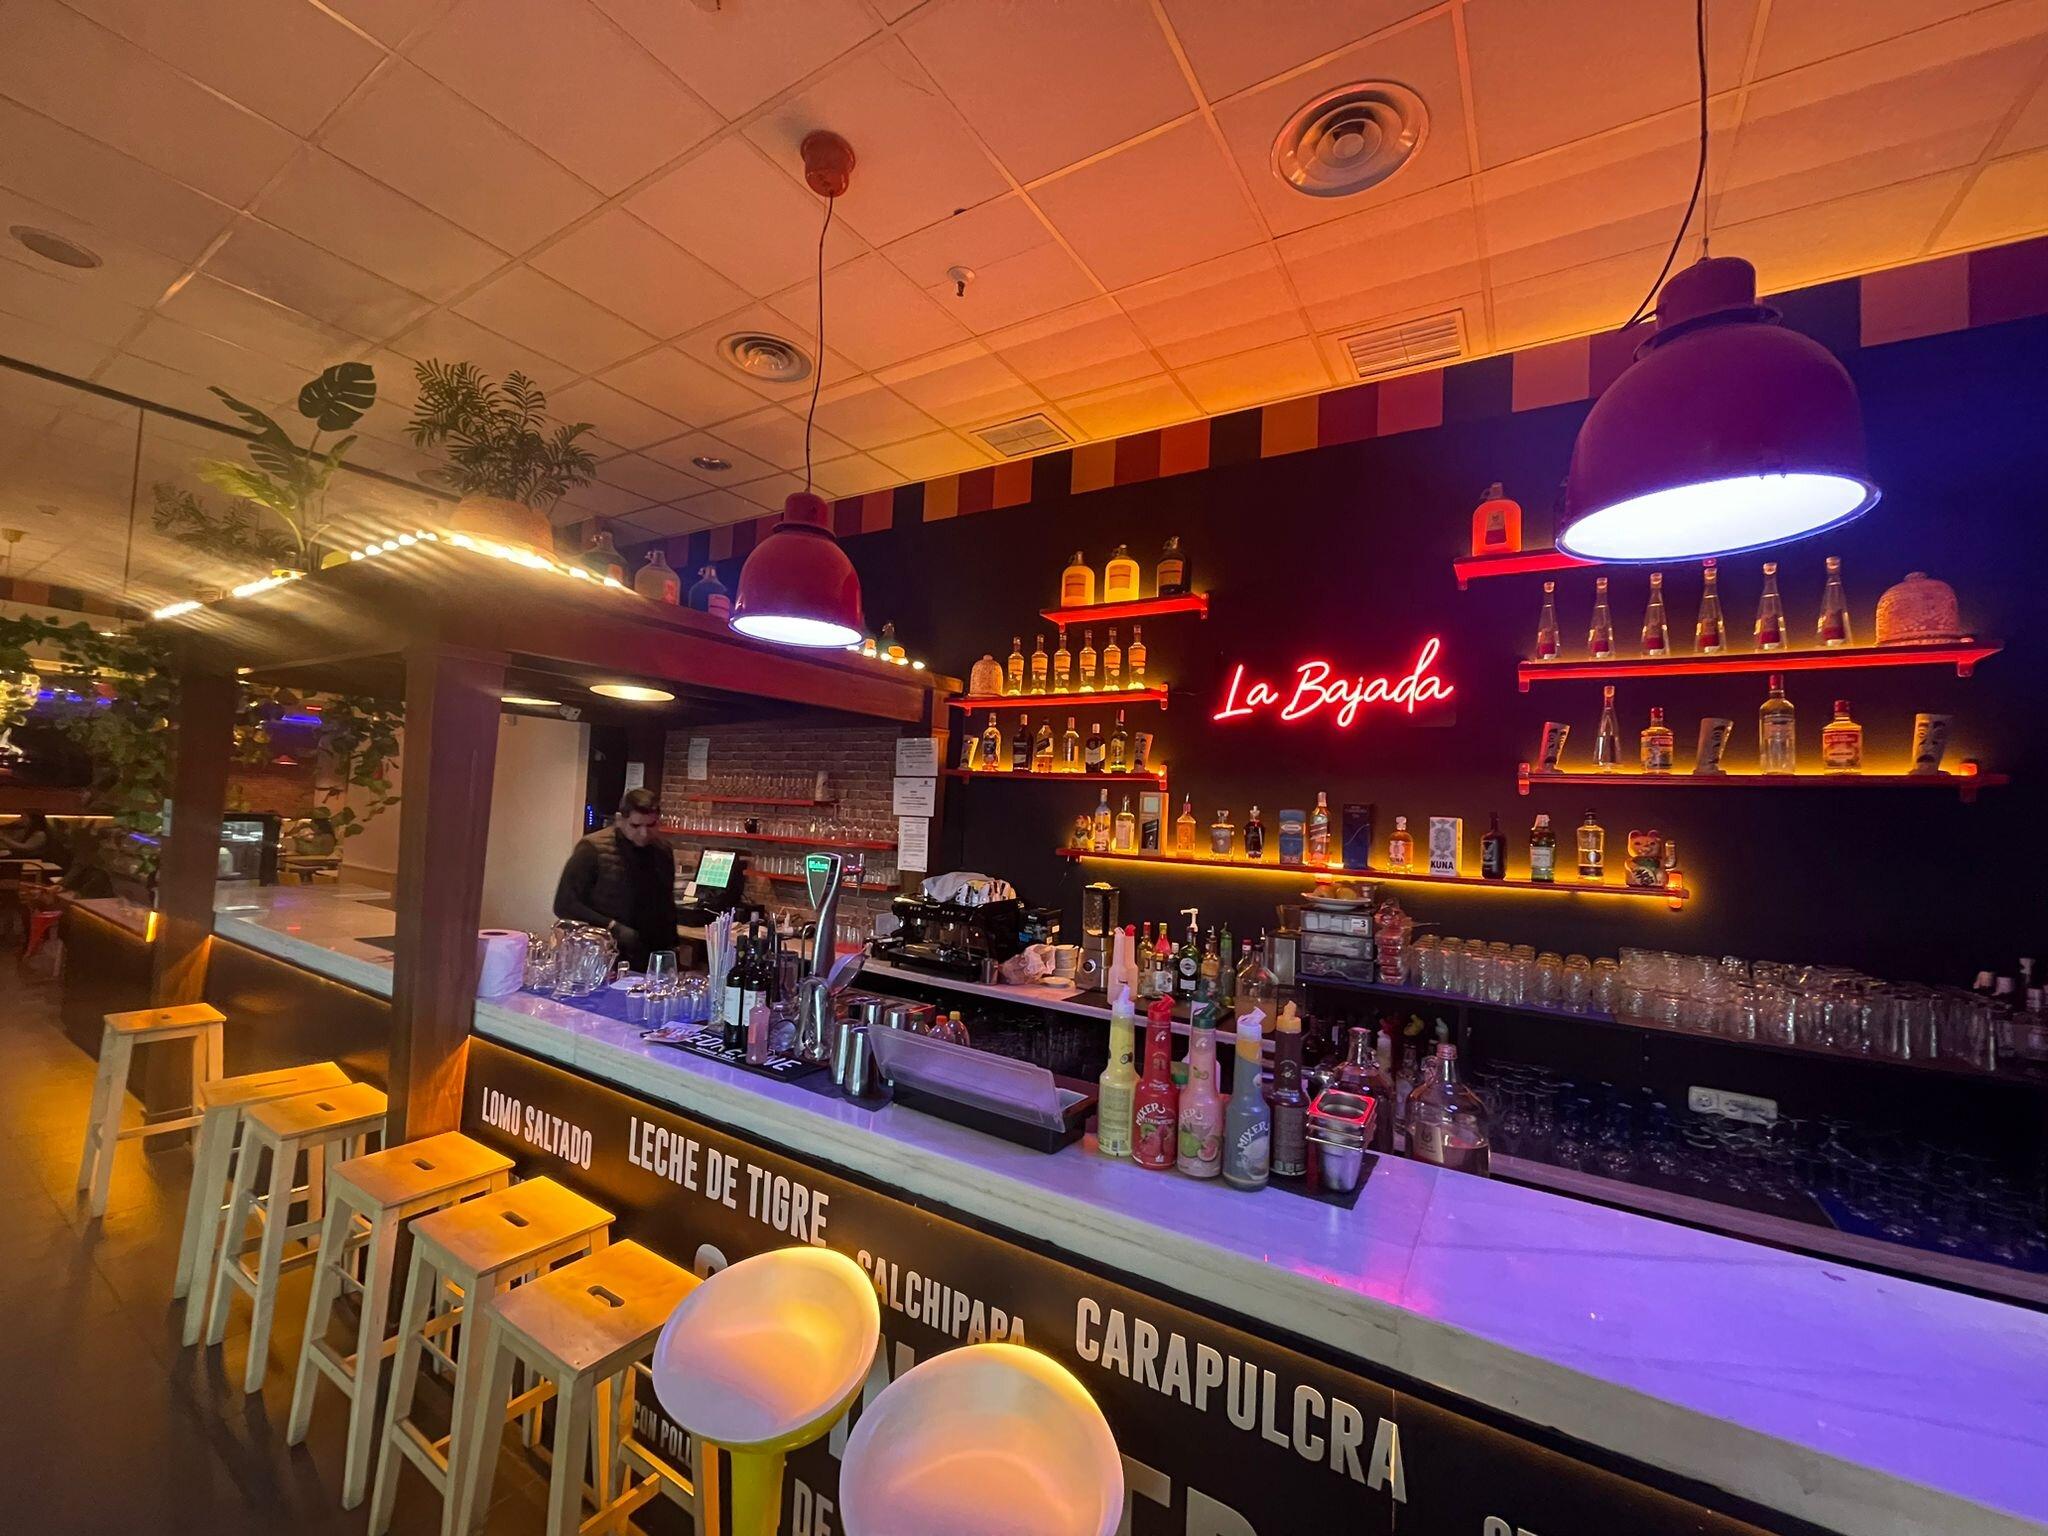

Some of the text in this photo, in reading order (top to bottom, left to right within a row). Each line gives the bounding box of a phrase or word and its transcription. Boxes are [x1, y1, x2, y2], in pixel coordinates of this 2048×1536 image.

[1213, 637, 1455, 728] La Bajada
[1430, 860, 1454, 870] KUNA
[1360, 919, 1367, 928] 3
[481, 1086, 593, 1172] LOMO SALTADO
[1136, 1102, 1166, 1126] MIXER
[1237, 1120, 1270, 1150] MIXER
[628, 1116, 830, 1248] LECHE DE TIGRE
[1074, 1297, 1408, 1504] CARAPULCRA
[632, 1399, 692, 1467] CON POLL
[792, 1477, 834, 1536] DE
